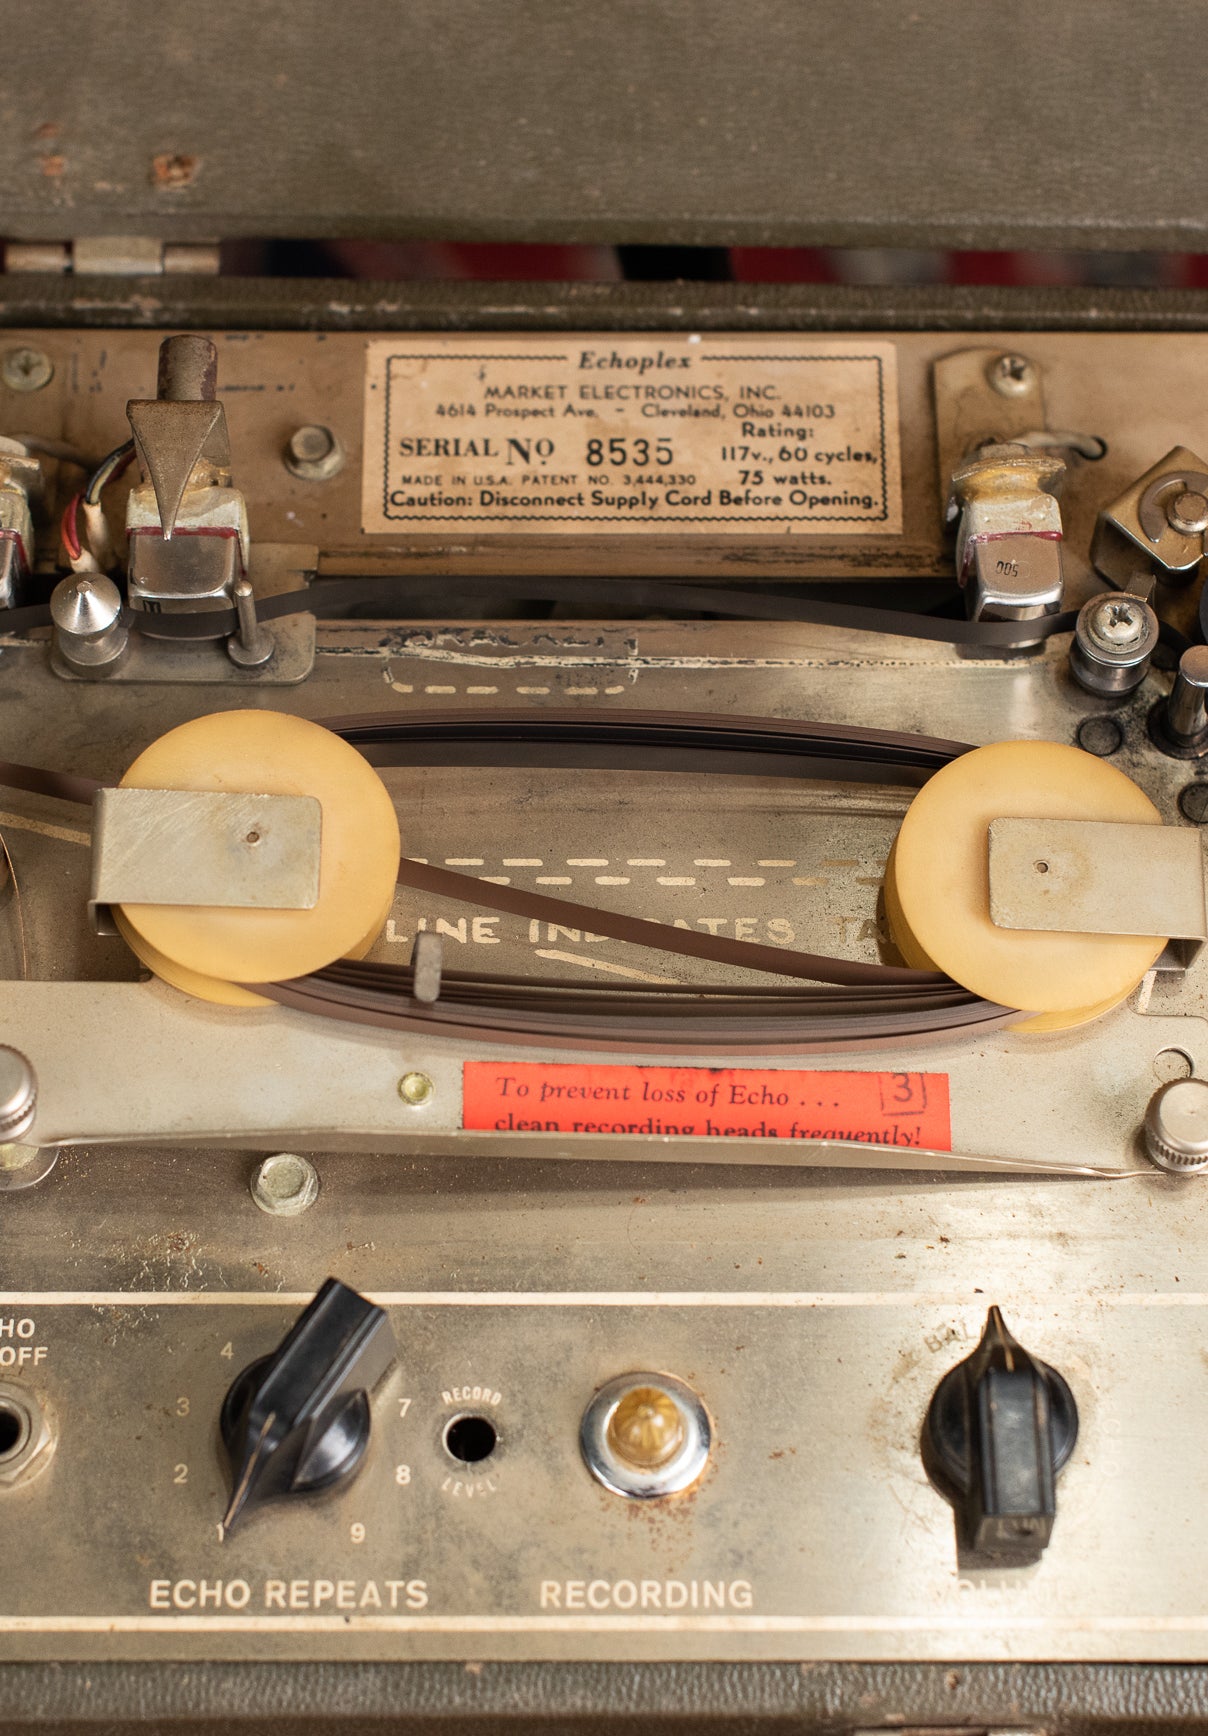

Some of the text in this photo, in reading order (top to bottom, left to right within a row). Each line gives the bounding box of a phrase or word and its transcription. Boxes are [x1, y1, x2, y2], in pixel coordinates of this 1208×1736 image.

[578, 351, 692, 376] Echoplex
[483, 384, 782, 402] MARKET ELECTRONICS, INC.
[435, 403, 477, 418] 4614
[484, 402, 555, 420] Prospect
[562, 403, 599, 418] Ave.
[641, 403, 726, 420] Cleveland,
[732, 403, 775, 419] Ohio
[781, 404, 836, 419] 44103
[741, 421, 815, 441] Rating:
[399, 437, 499, 457] SERIAL
[586, 437, 674, 467] 8535
[778, 446, 808, 462] 60
[814, 446, 878, 465] cycles,
[402, 475, 443, 486] MADE
[452, 475, 467, 486] IN
[521, 475, 578, 486] PATENT
[623, 474, 697, 488] 3,444,330
[738, 470, 833, 486] 75 watts.
[390, 489, 880, 510] Caution: Disconnect Supply Cord Before Opening.
[495, 1077, 530, 1098] To
[540, 1080, 632, 1102] prevent
[642, 1082, 687, 1104] loss
[695, 1083, 721, 1108] of
[728, 1084, 790, 1106] Echo
[494, 1113, 560, 1133] clean
[220, 1342, 235, 1360] 4
[176, 1397, 191, 1416] 3
[441, 1386, 503, 1407] RECORD
[398, 1398, 412, 1418] 7
[173, 1464, 188, 1484] 2
[395, 1464, 411, 1486] 8
[441, 1477, 497, 1498] LEVEL
[350, 1522, 366, 1544] 9
[149, 1579, 429, 1610] ECHO REPEATS
[539, 1579, 754, 1611] RECORDING
